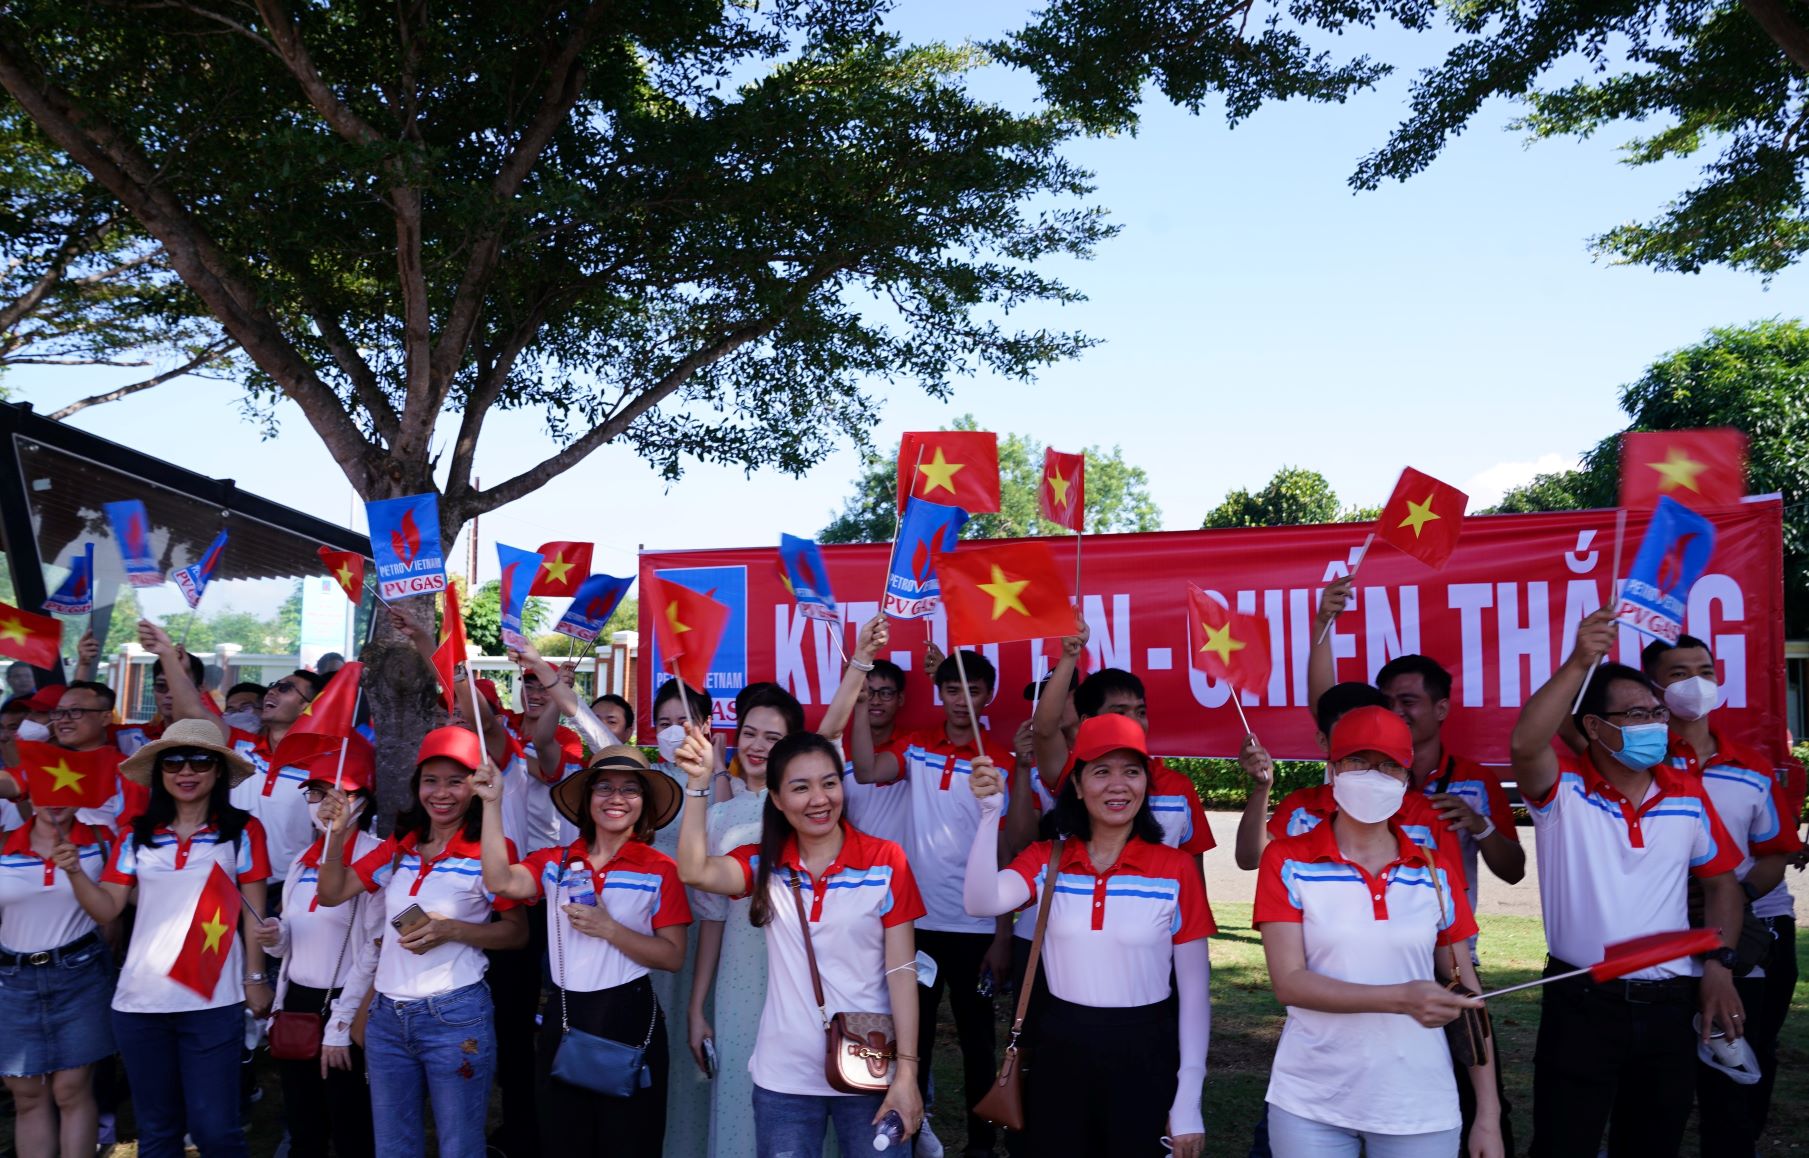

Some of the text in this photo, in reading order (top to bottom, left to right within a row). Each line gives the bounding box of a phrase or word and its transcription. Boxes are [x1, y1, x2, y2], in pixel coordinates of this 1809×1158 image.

[384, 575, 444, 597] PV GAS
[884, 594, 910, 614] PV
[656, 671, 743, 689] PEETNAM
[711, 700, 737, 721] AS
